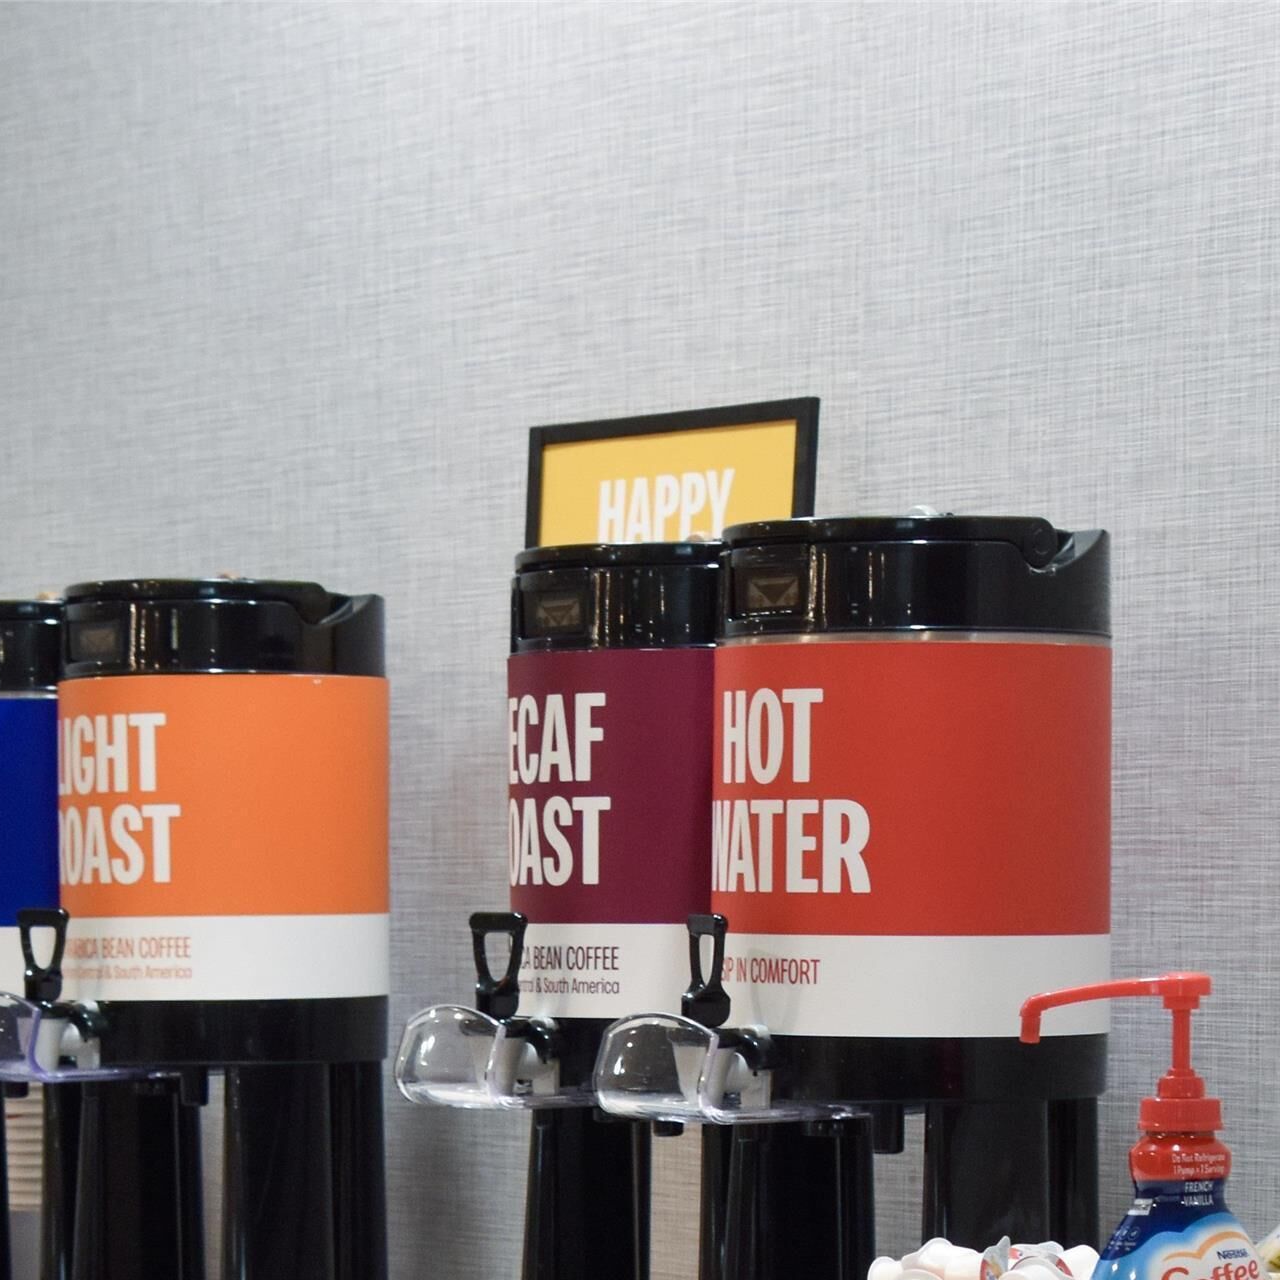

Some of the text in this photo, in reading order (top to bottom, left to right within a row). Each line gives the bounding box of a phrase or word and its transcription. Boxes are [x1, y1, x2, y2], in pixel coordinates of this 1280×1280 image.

[597, 468, 736, 545] HAPPY
[722, 687, 824, 785] HOT
[711, 799, 871, 893] WATER
[101, 935, 134, 959] BEAN
[138, 935, 192, 959] COFFEE
[533, 945, 563, 970] BEAN
[566, 945, 619, 971] COFFEE
[736, 957, 747, 983] IN
[750, 957, 821, 985] COMFORT
[544, 977, 569, 994] South
[571, 978, 620, 994] America
[1183, 1194, 1214, 1207] VANILLA
